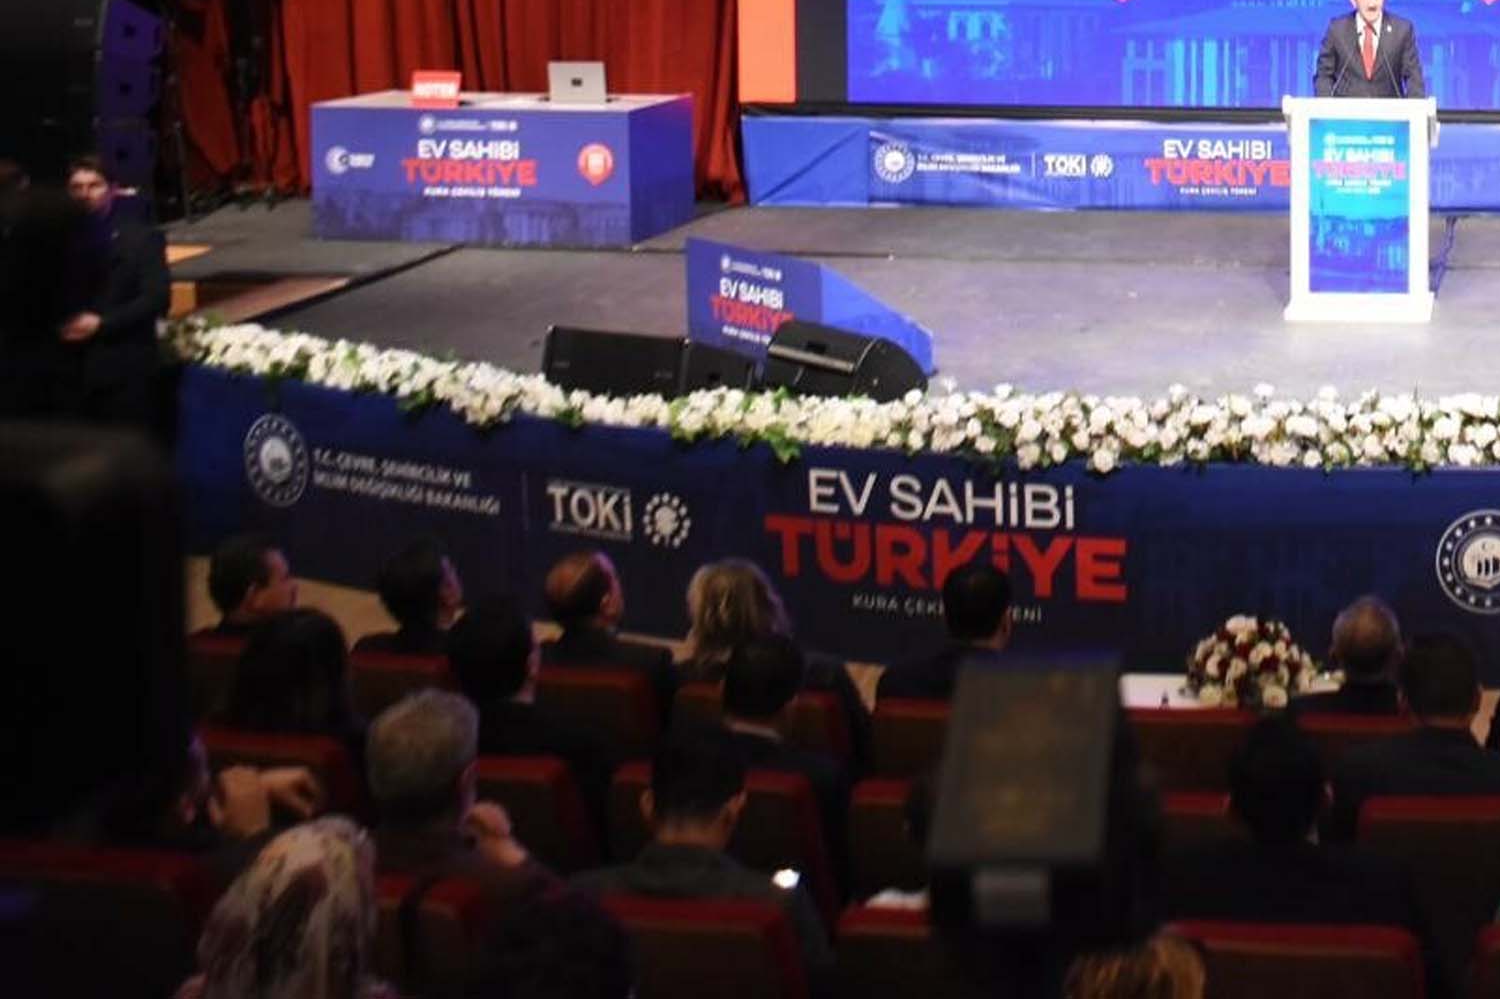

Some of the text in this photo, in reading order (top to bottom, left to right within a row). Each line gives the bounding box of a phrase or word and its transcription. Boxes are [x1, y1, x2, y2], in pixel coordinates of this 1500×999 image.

[418, 139, 447, 159] EV
[1163, 139, 1193, 159] EV
[720, 277, 738, 299] EV
[807, 467, 1075, 530] EV SAHİBİ
